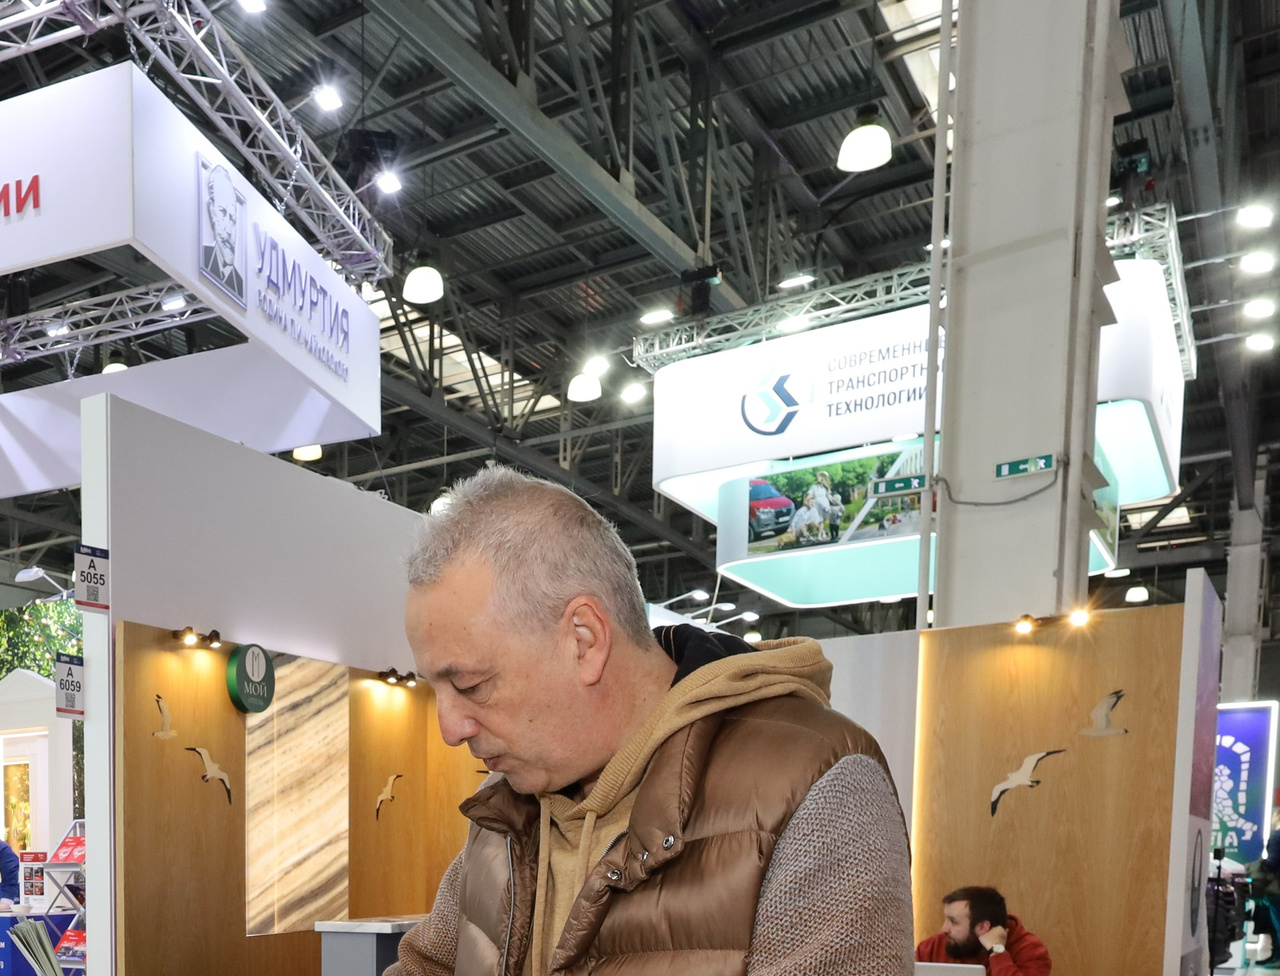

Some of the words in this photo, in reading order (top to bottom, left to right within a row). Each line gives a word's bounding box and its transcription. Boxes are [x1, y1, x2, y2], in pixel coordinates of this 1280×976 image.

[252, 222, 350, 354] УДМУРТИЯ
[827, 362, 928, 395] ТРАНСПОРТН
[826, 386, 928, 417] ТЕХНОЛОГИИ
[87, 558, 97, 571] A
[80, 570, 106, 586] 5055
[66, 666, 74, 678] A
[59, 678, 82, 693] 6059
[243, 681, 268, 698] МОЙ
